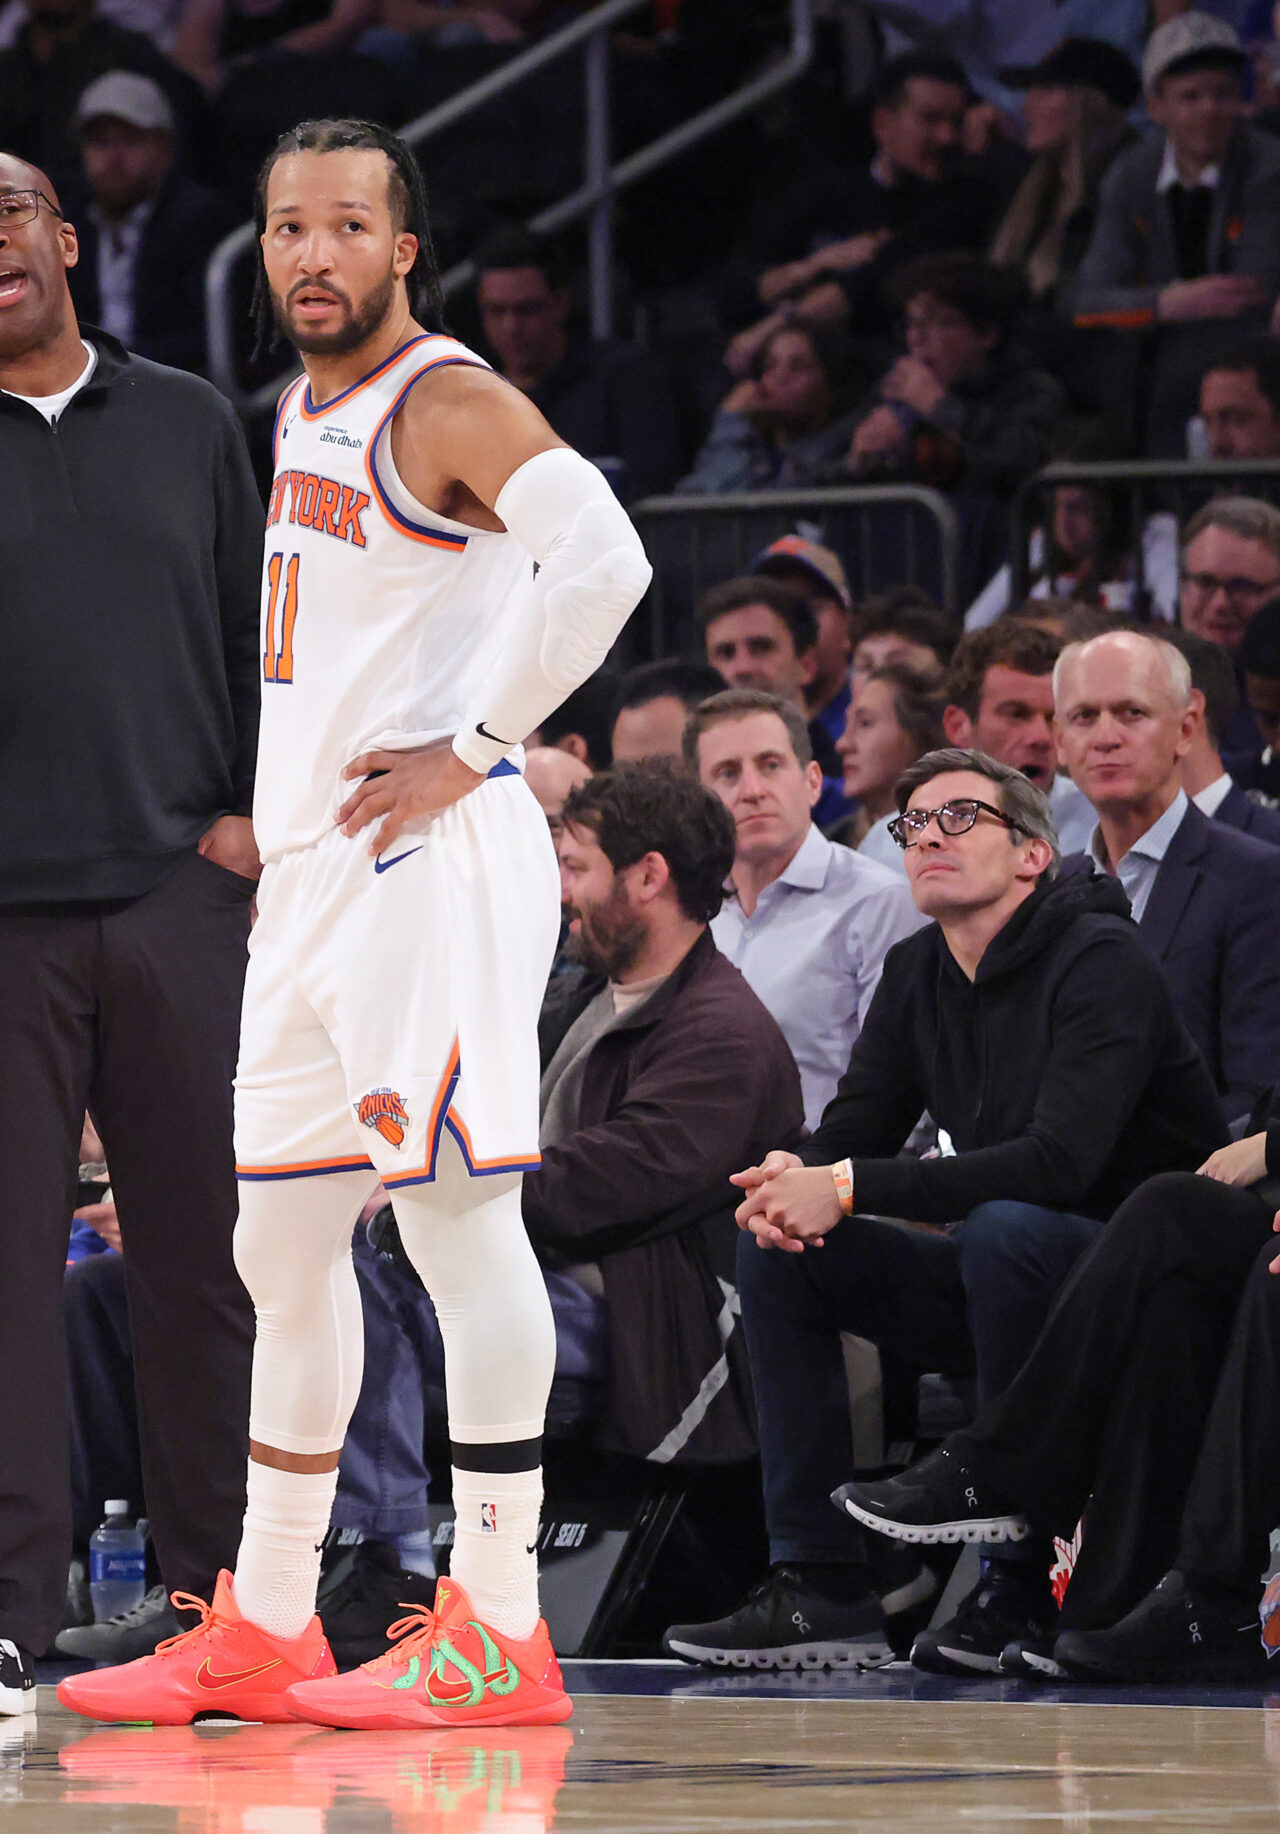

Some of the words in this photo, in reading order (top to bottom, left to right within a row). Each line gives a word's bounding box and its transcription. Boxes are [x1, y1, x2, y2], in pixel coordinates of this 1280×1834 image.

[320, 432, 338, 443] abu
[288, 470, 371, 551] YORK
[263, 552, 300, 684] 11
[359, 1092, 408, 1123] KNICKS
